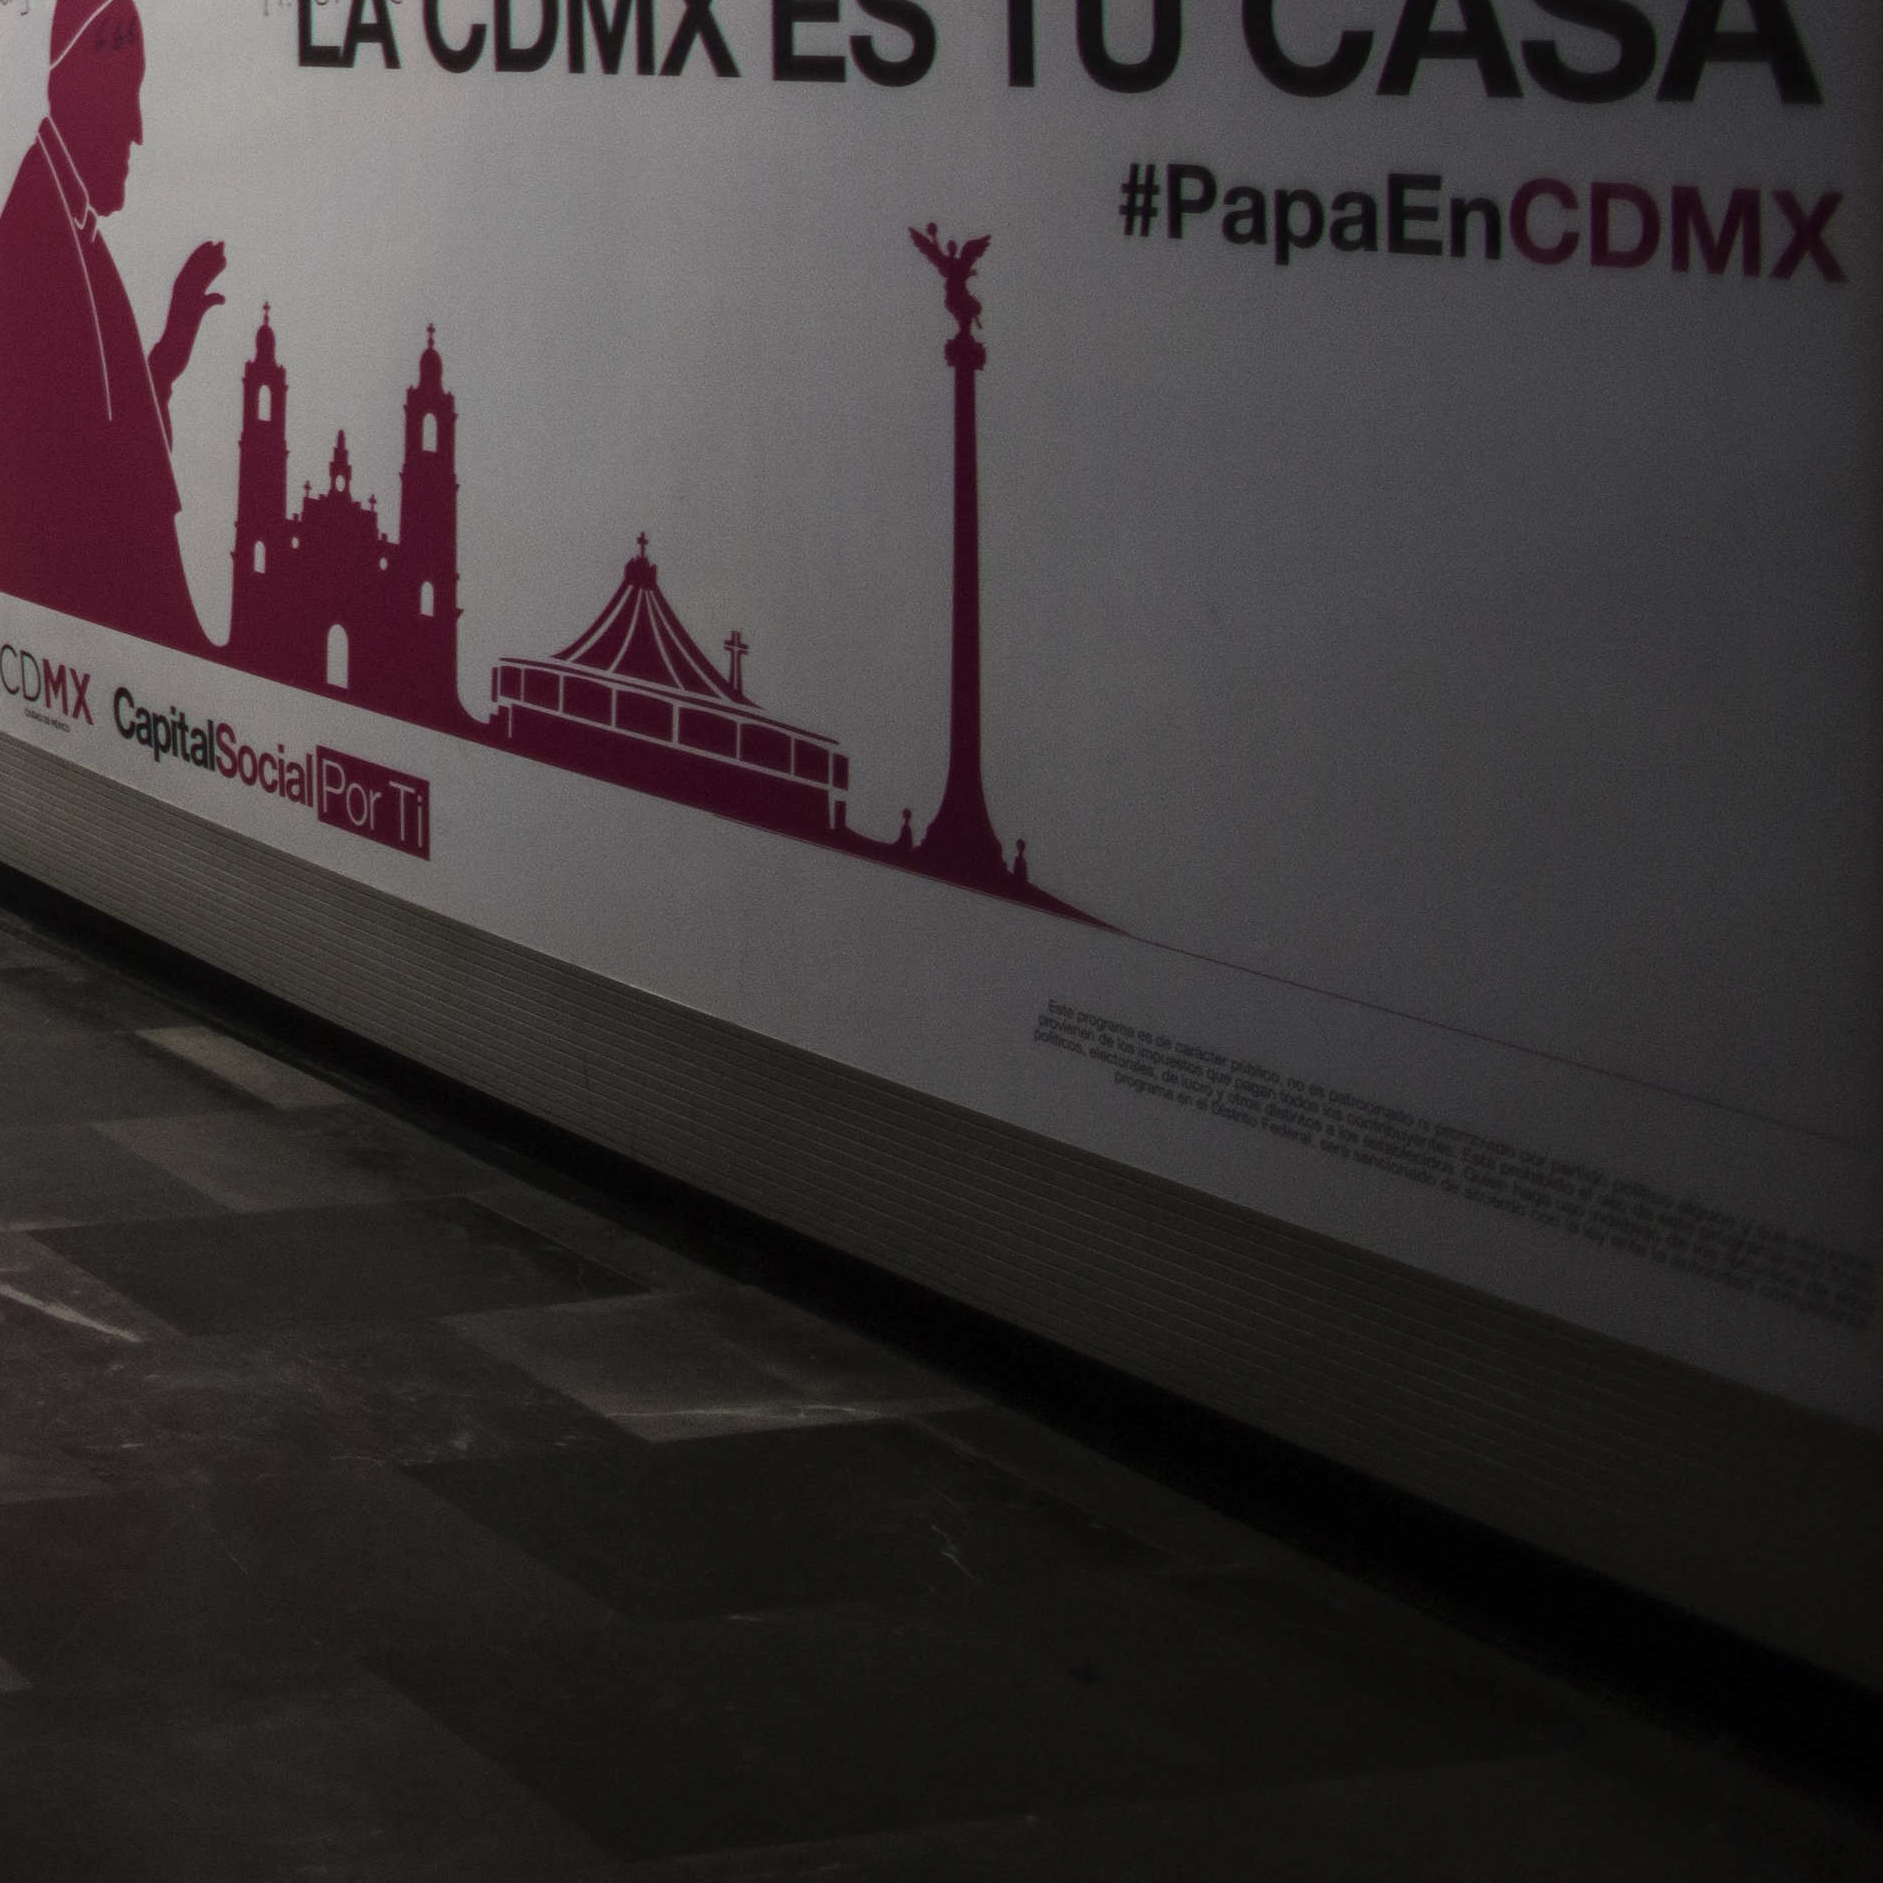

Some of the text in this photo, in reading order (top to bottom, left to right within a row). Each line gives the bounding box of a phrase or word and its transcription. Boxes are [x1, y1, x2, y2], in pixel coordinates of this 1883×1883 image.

[1121, 159, 1848, 283] #PapaEnCDMX
[0, 643, 94, 726] CDMX
[113, 686, 424, 848] CapitalSocial Por Ti
